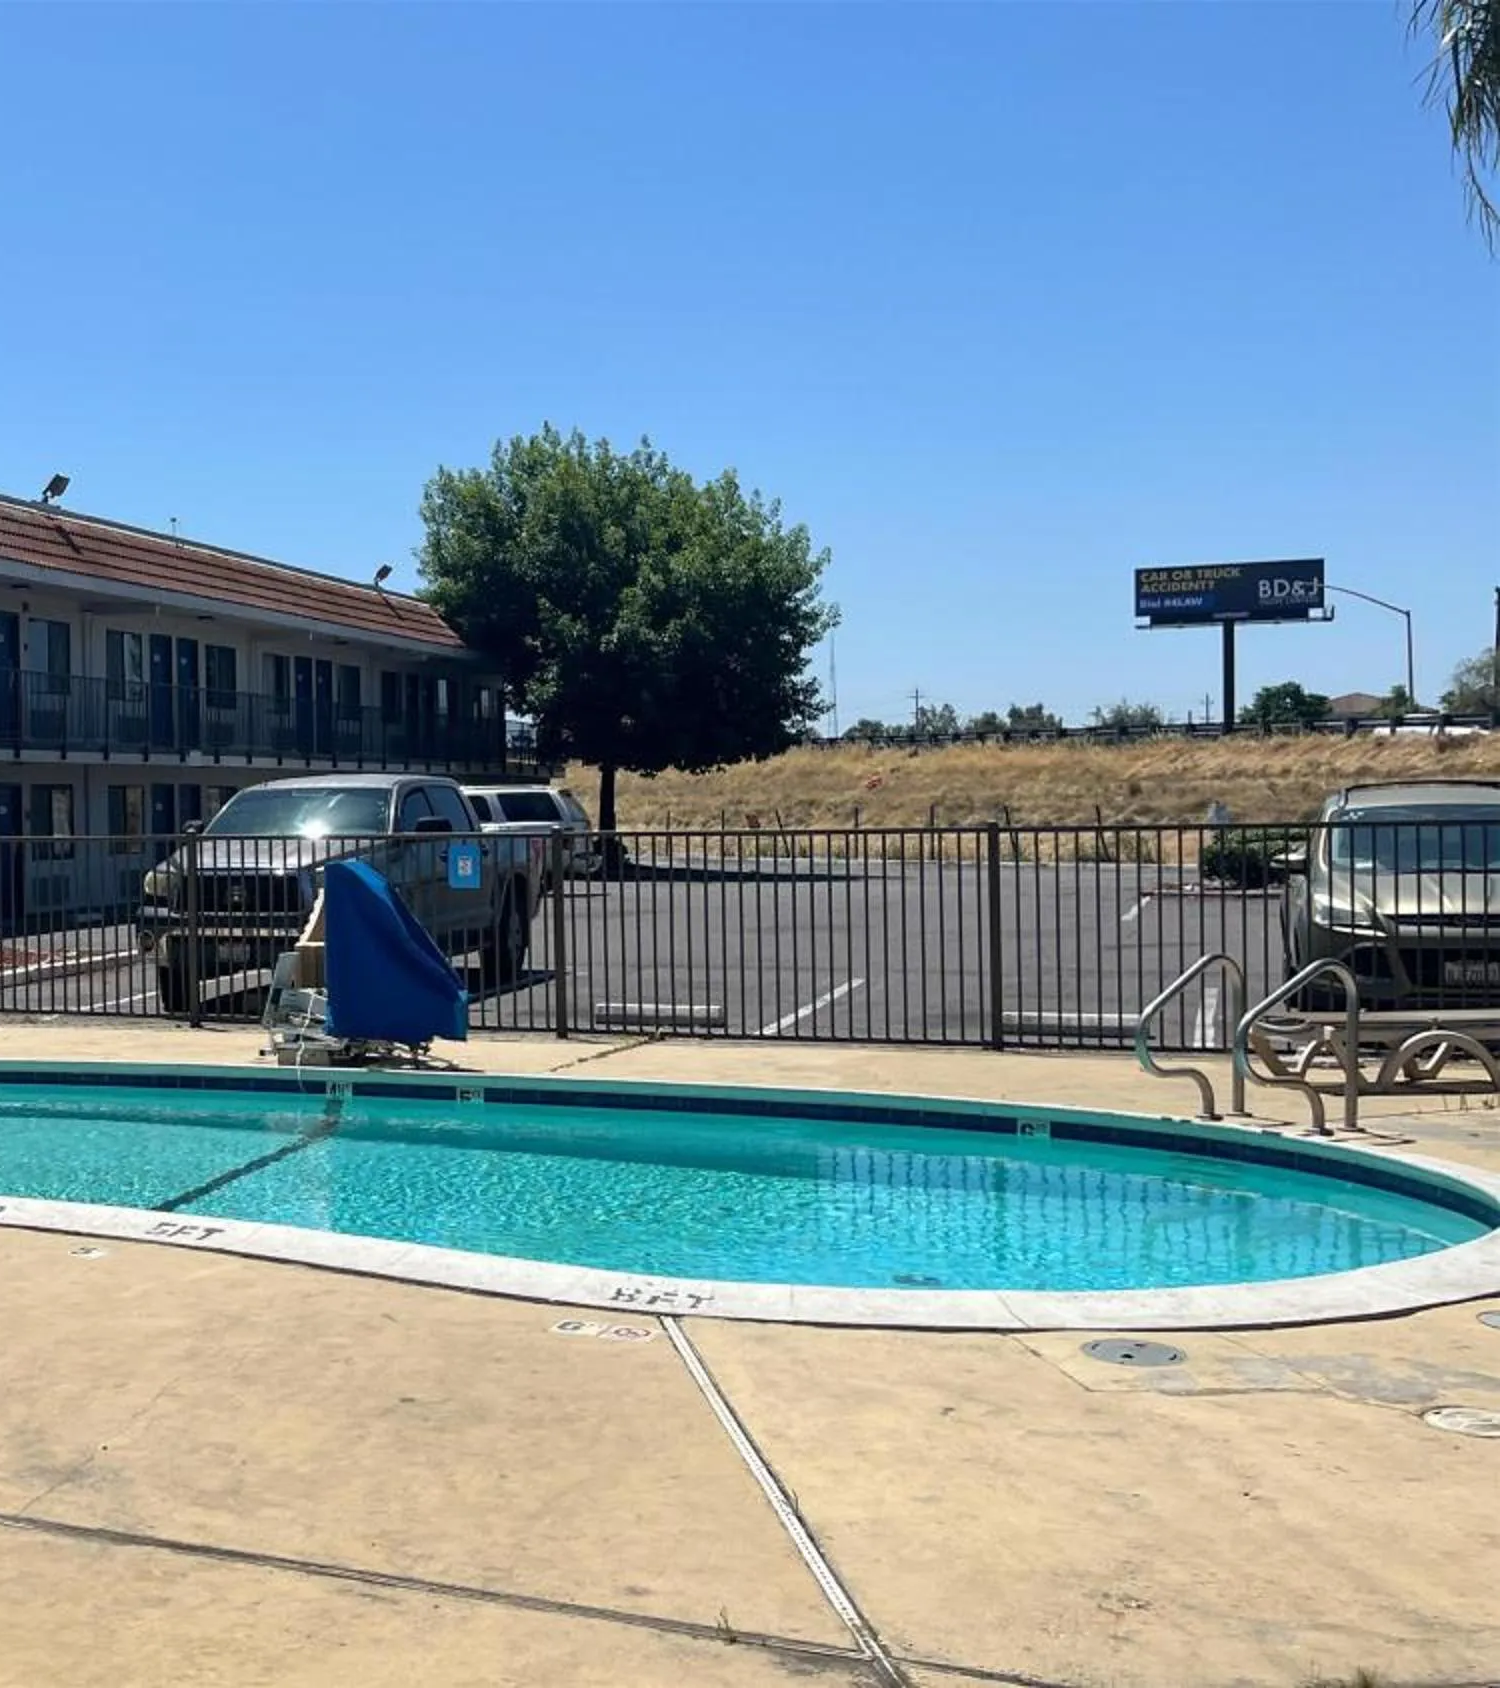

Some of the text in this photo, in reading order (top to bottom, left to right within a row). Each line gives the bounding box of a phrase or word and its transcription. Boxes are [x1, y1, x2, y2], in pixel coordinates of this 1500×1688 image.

[1140, 571, 1168, 583] CAR
[1196, 567, 1242, 579] TRUCK
[1258, 576, 1318, 599] BD&J
